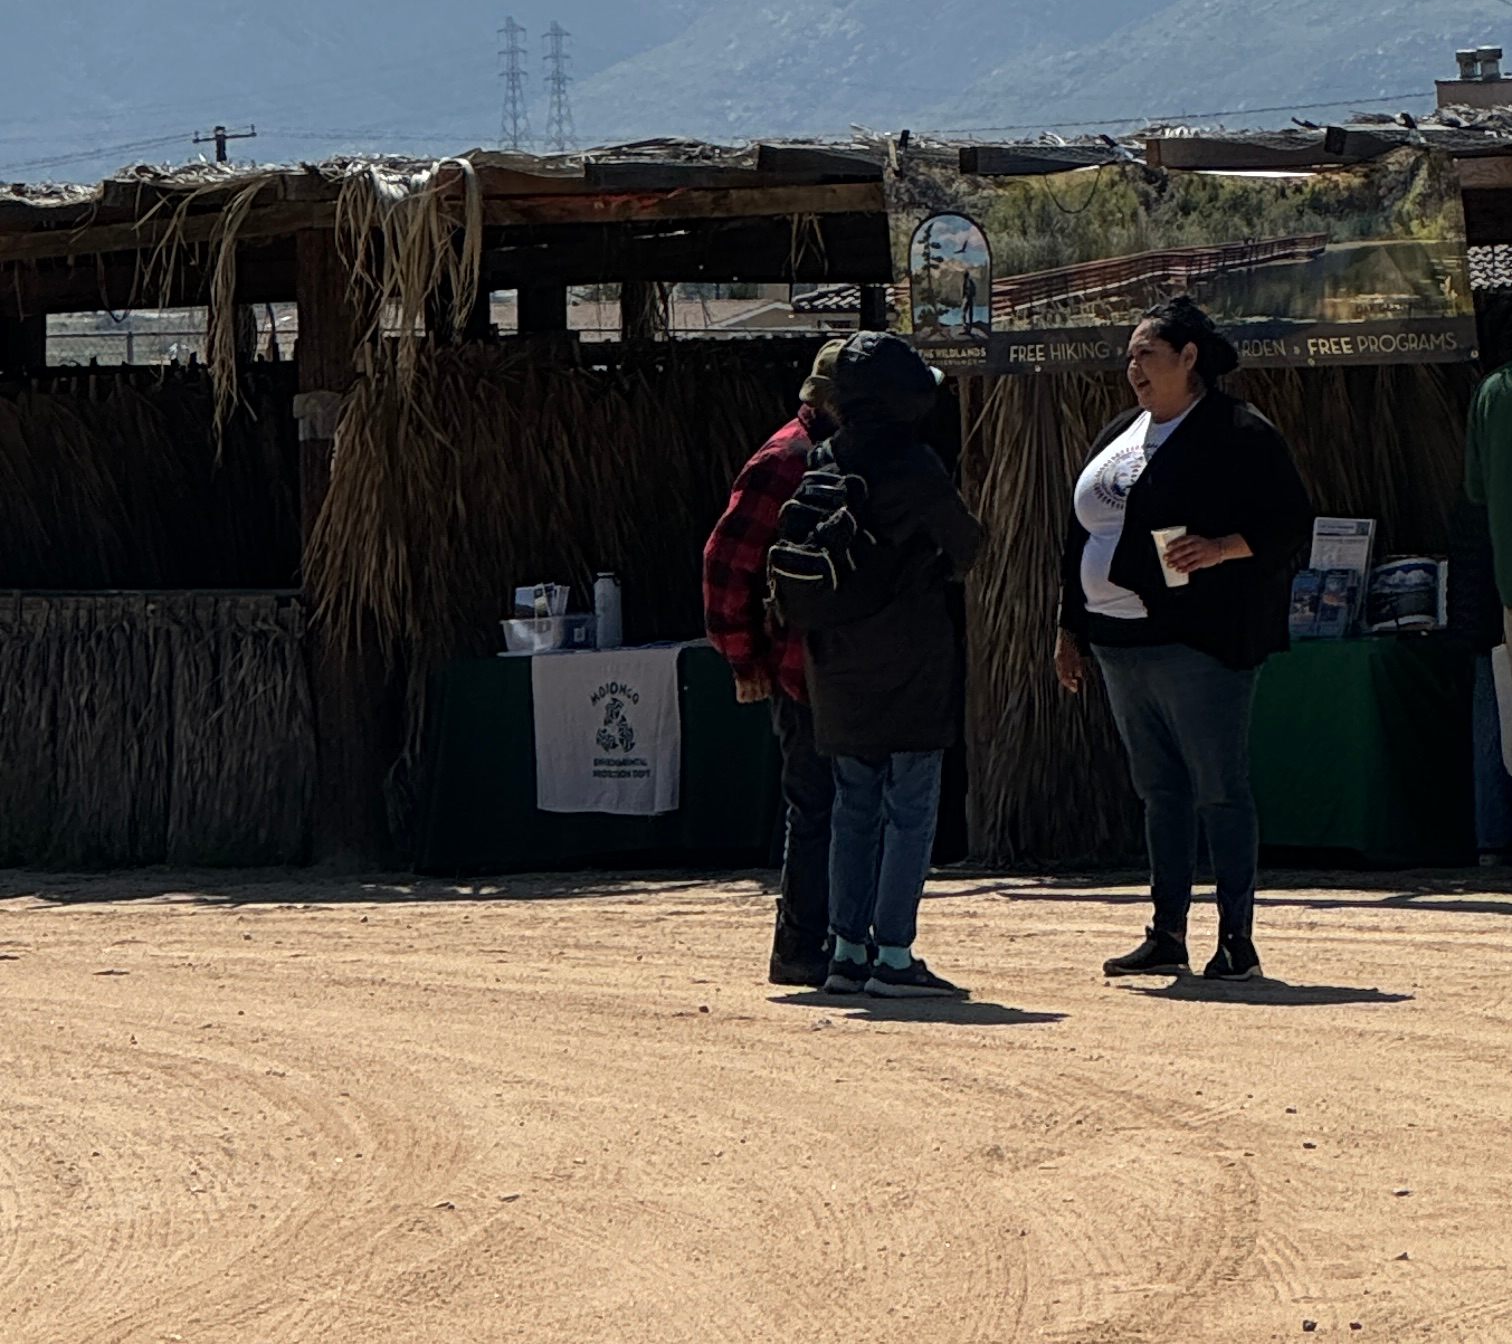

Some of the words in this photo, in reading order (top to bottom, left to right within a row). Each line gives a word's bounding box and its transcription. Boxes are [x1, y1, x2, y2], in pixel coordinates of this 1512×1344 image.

[936, 347, 987, 358] WILDLANDS
[1009, 344, 1046, 363] FREE
[1050, 341, 1111, 362] HIKING
[1306, 336, 1355, 357] FREE
[1357, 332, 1458, 355] PROGRAMS
